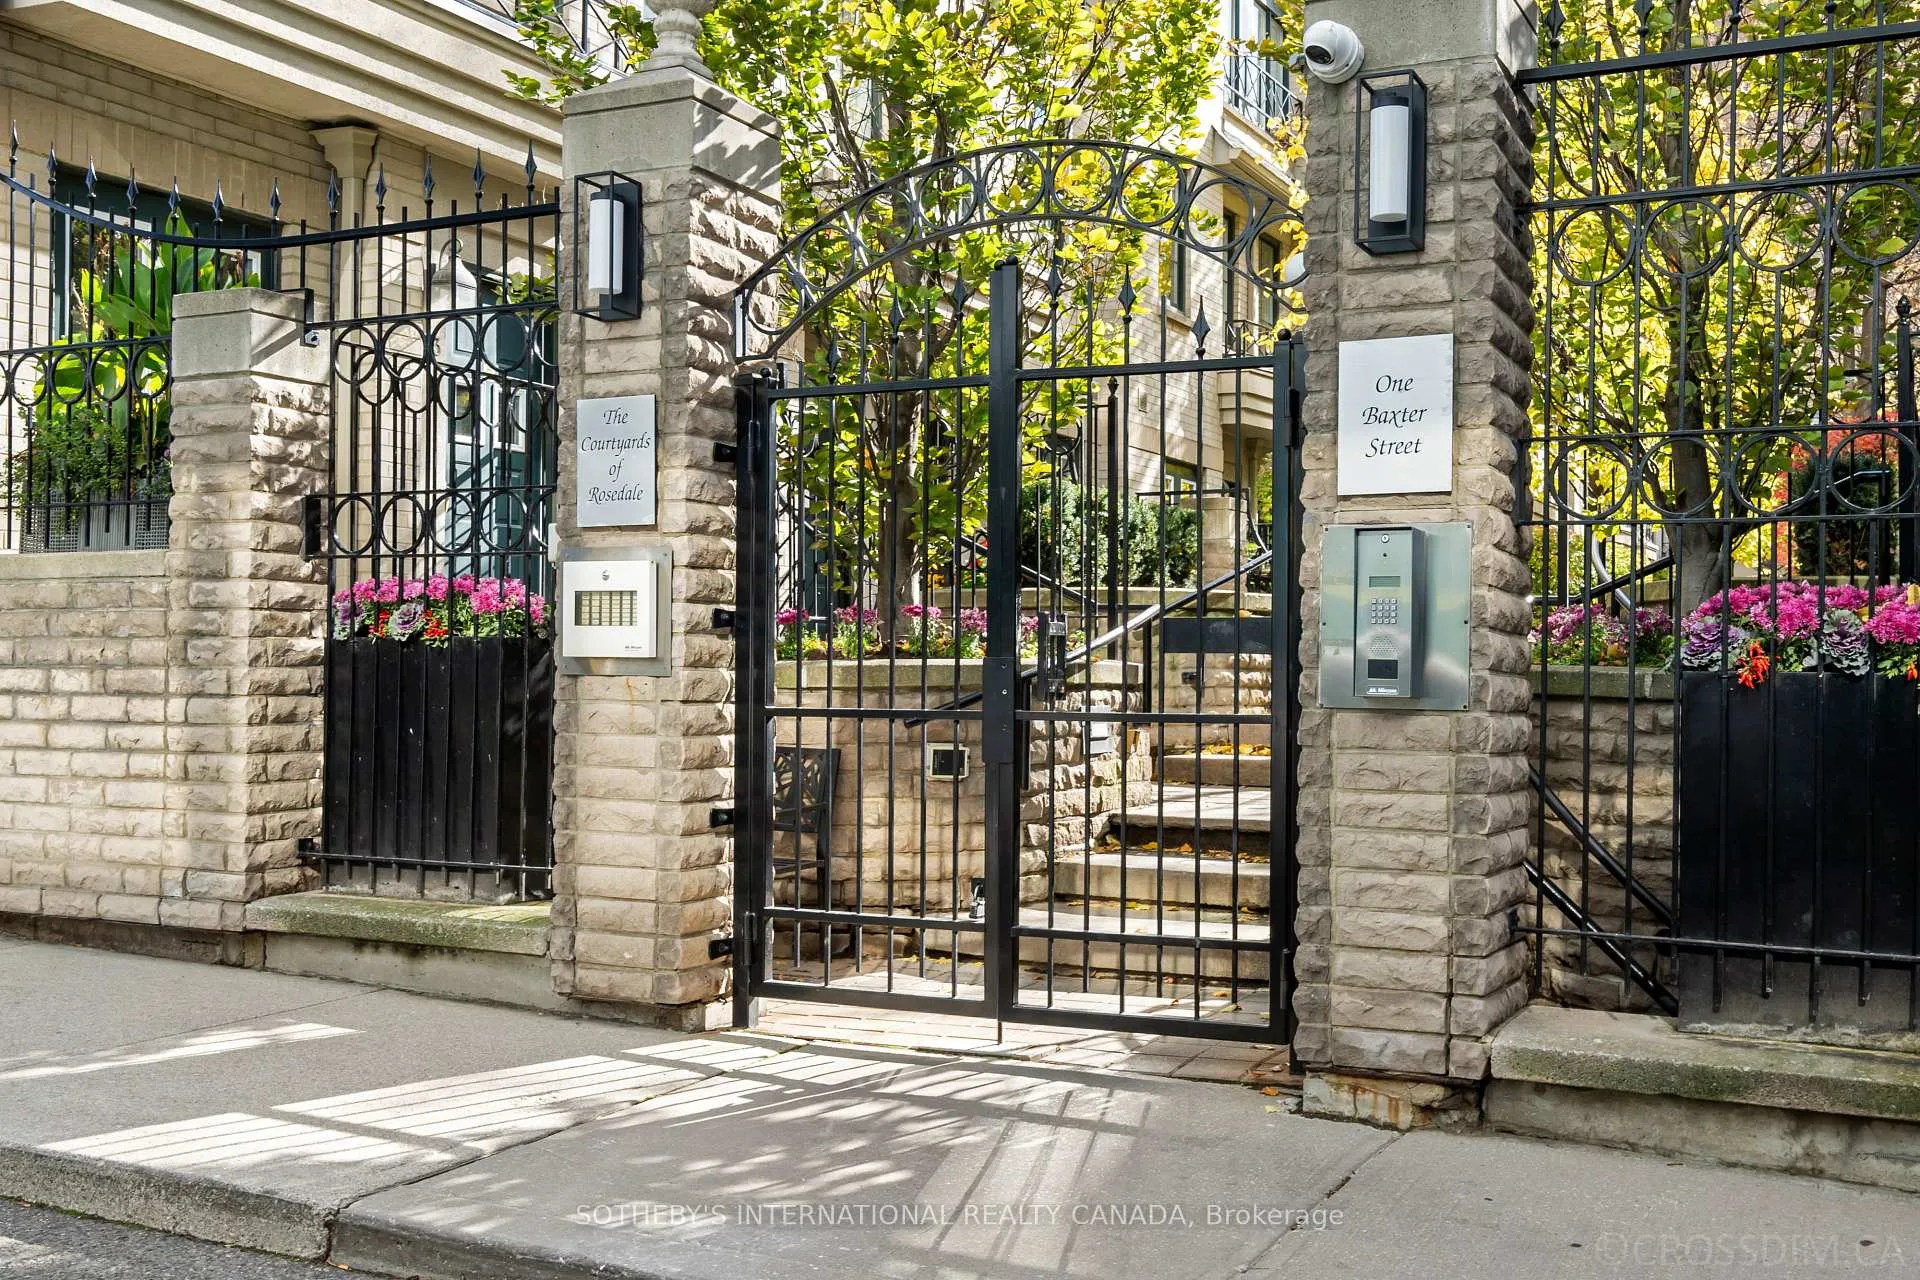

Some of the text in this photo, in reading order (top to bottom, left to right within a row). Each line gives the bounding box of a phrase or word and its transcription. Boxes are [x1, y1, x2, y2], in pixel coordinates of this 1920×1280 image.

[1375, 374, 1414, 393] One
[603, 407, 629, 425] The
[1362, 406, 1428, 429] Baxter
[581, 431, 651, 456] Courtyards
[1365, 437, 1422, 458] Street
[608, 458, 625, 483] of
[587, 483, 644, 505] Rosedale
